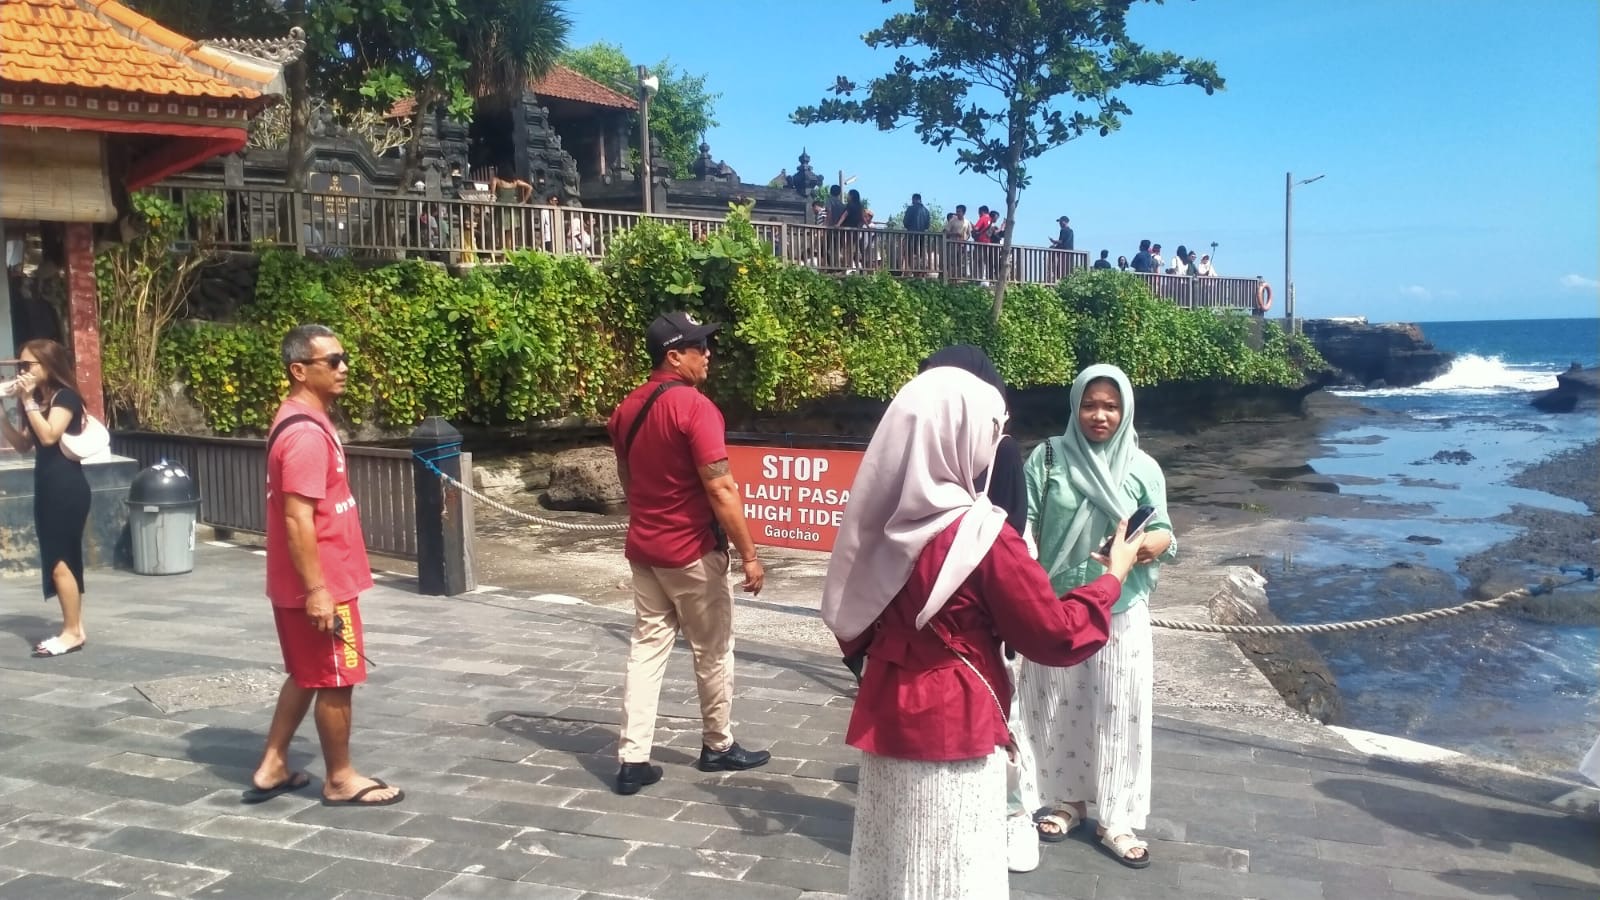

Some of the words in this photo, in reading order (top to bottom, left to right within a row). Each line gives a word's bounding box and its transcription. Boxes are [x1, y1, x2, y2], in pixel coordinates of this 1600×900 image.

[762, 454, 829, 482] STOP
[745, 483, 793, 502] LAUT
[744, 503, 792, 522] HIGH
[798, 508, 844, 527] TIDE
